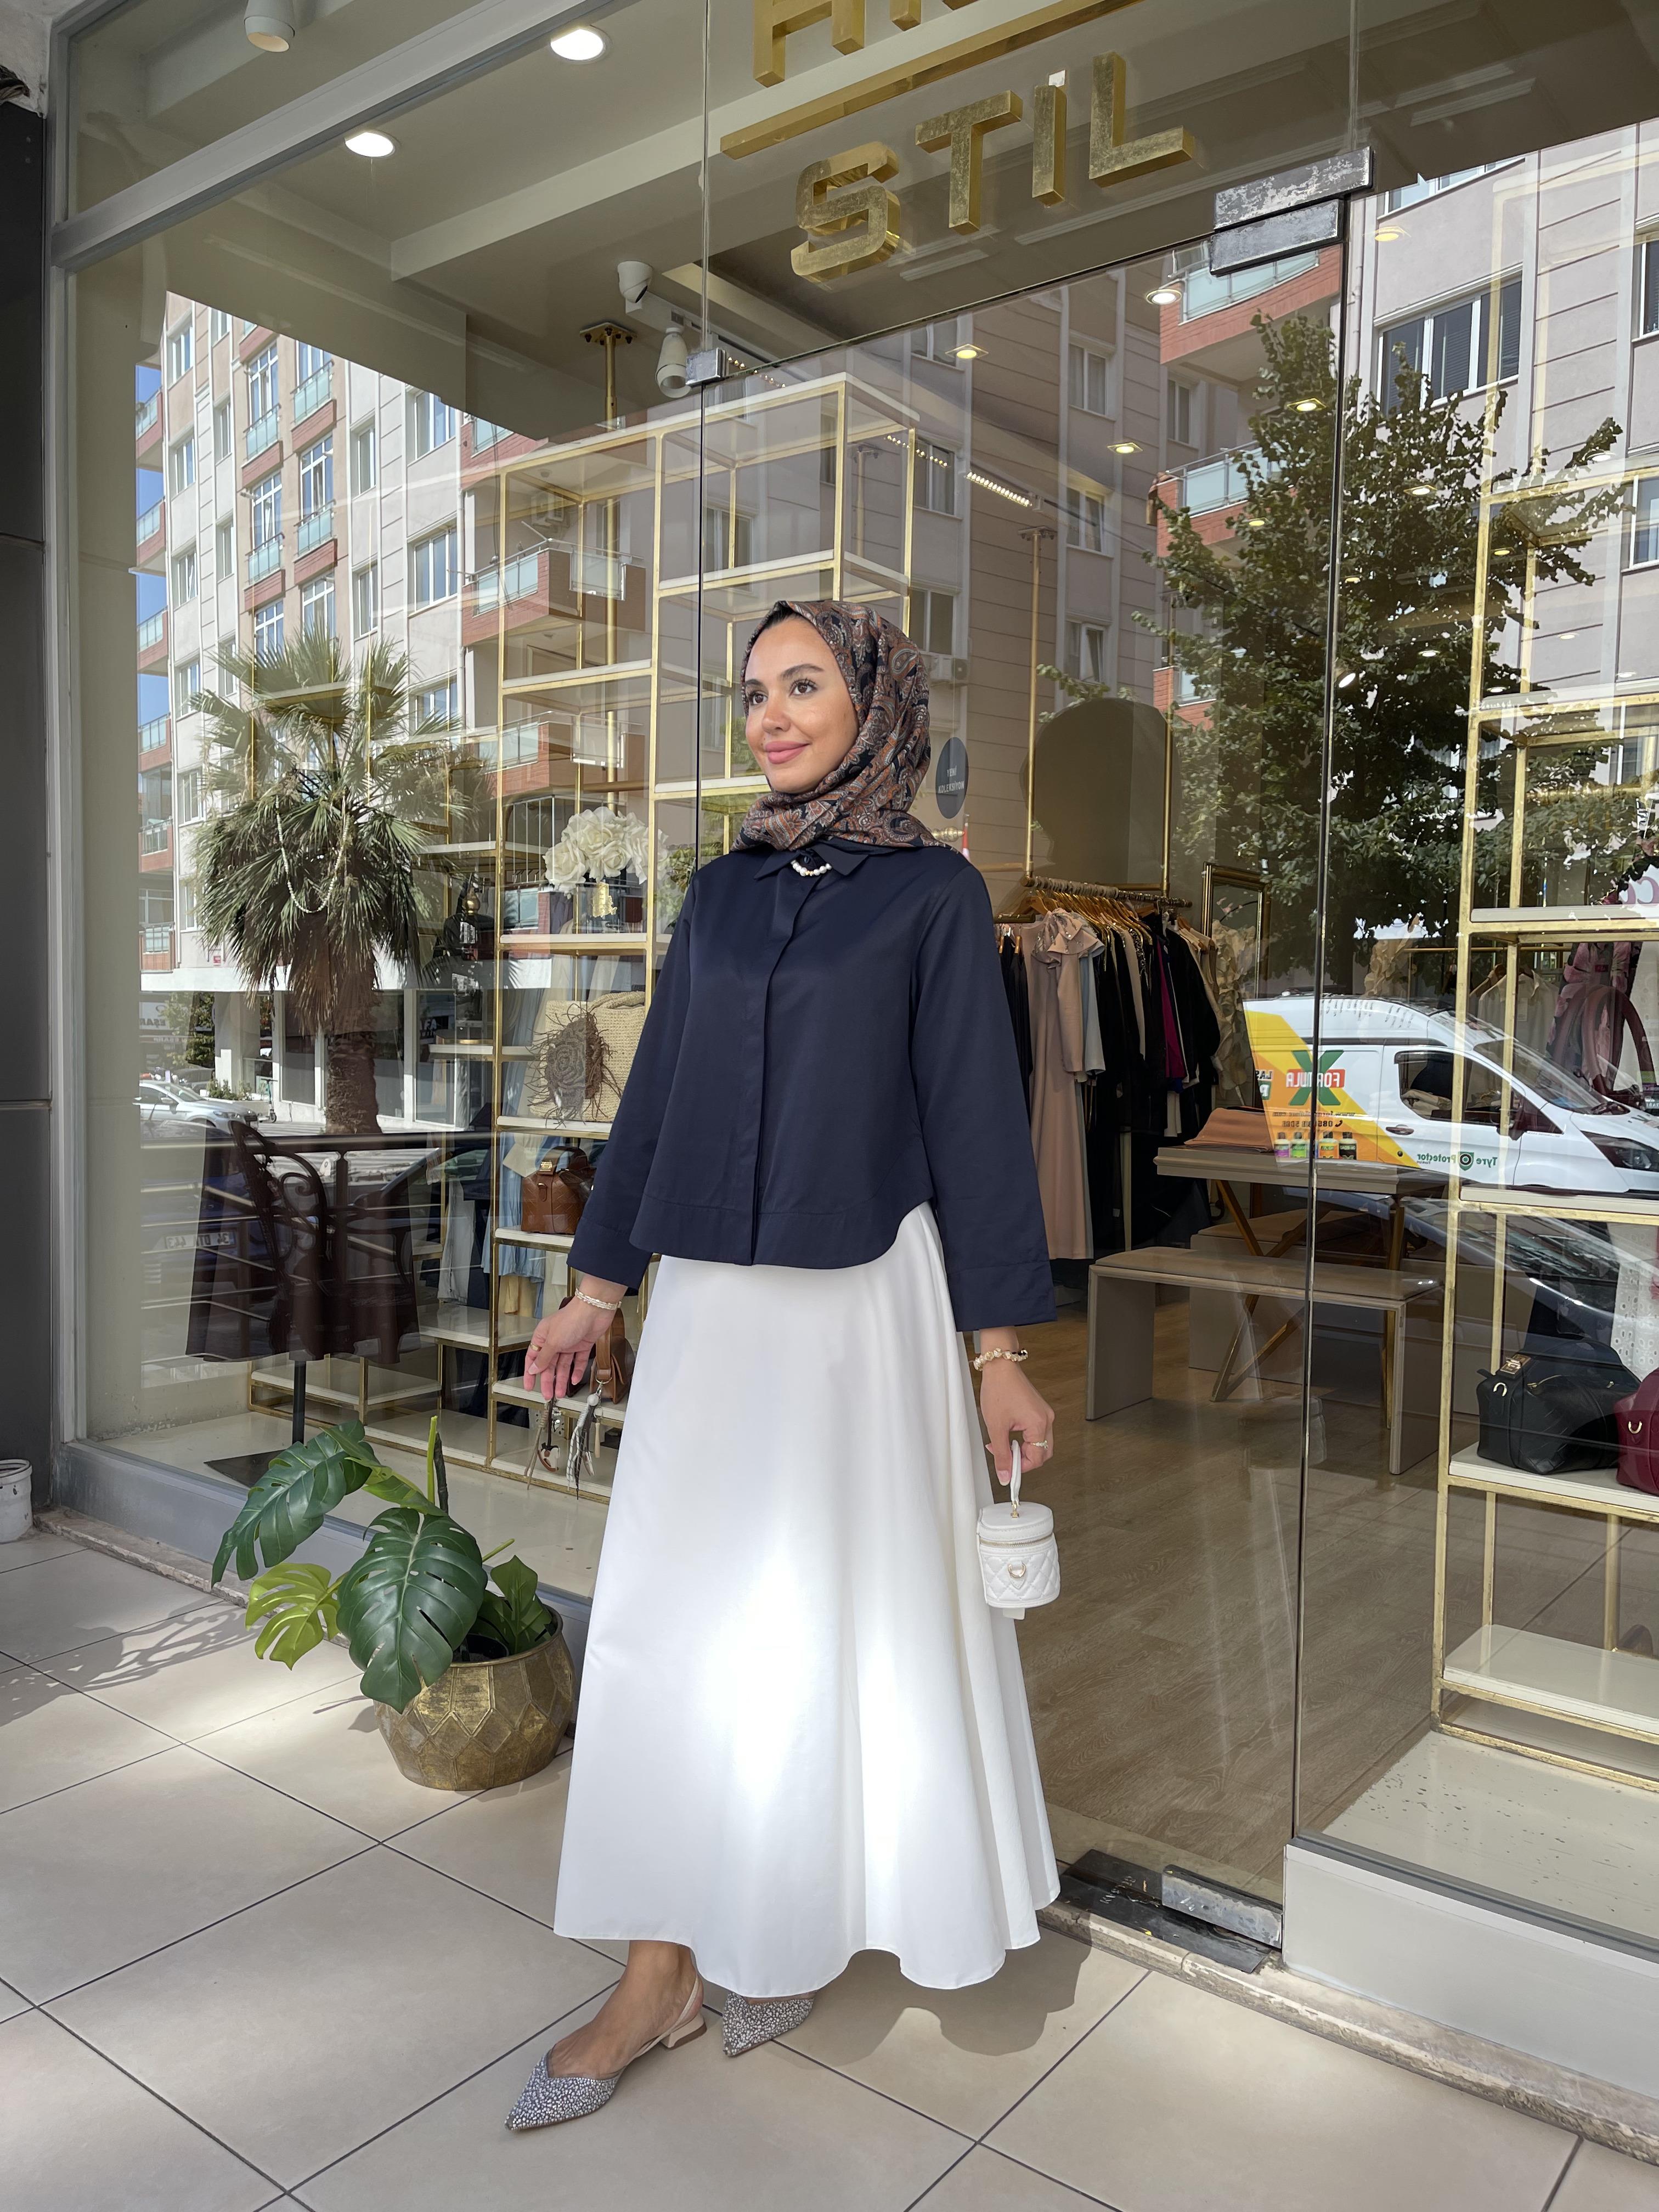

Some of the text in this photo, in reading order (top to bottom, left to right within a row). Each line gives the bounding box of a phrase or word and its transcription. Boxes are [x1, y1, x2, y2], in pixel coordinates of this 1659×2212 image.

[791, 52, 1195, 283] STIL
[947, 765, 957, 777] YENİ
[938, 781, 964, 794] KOLEKSİYON
